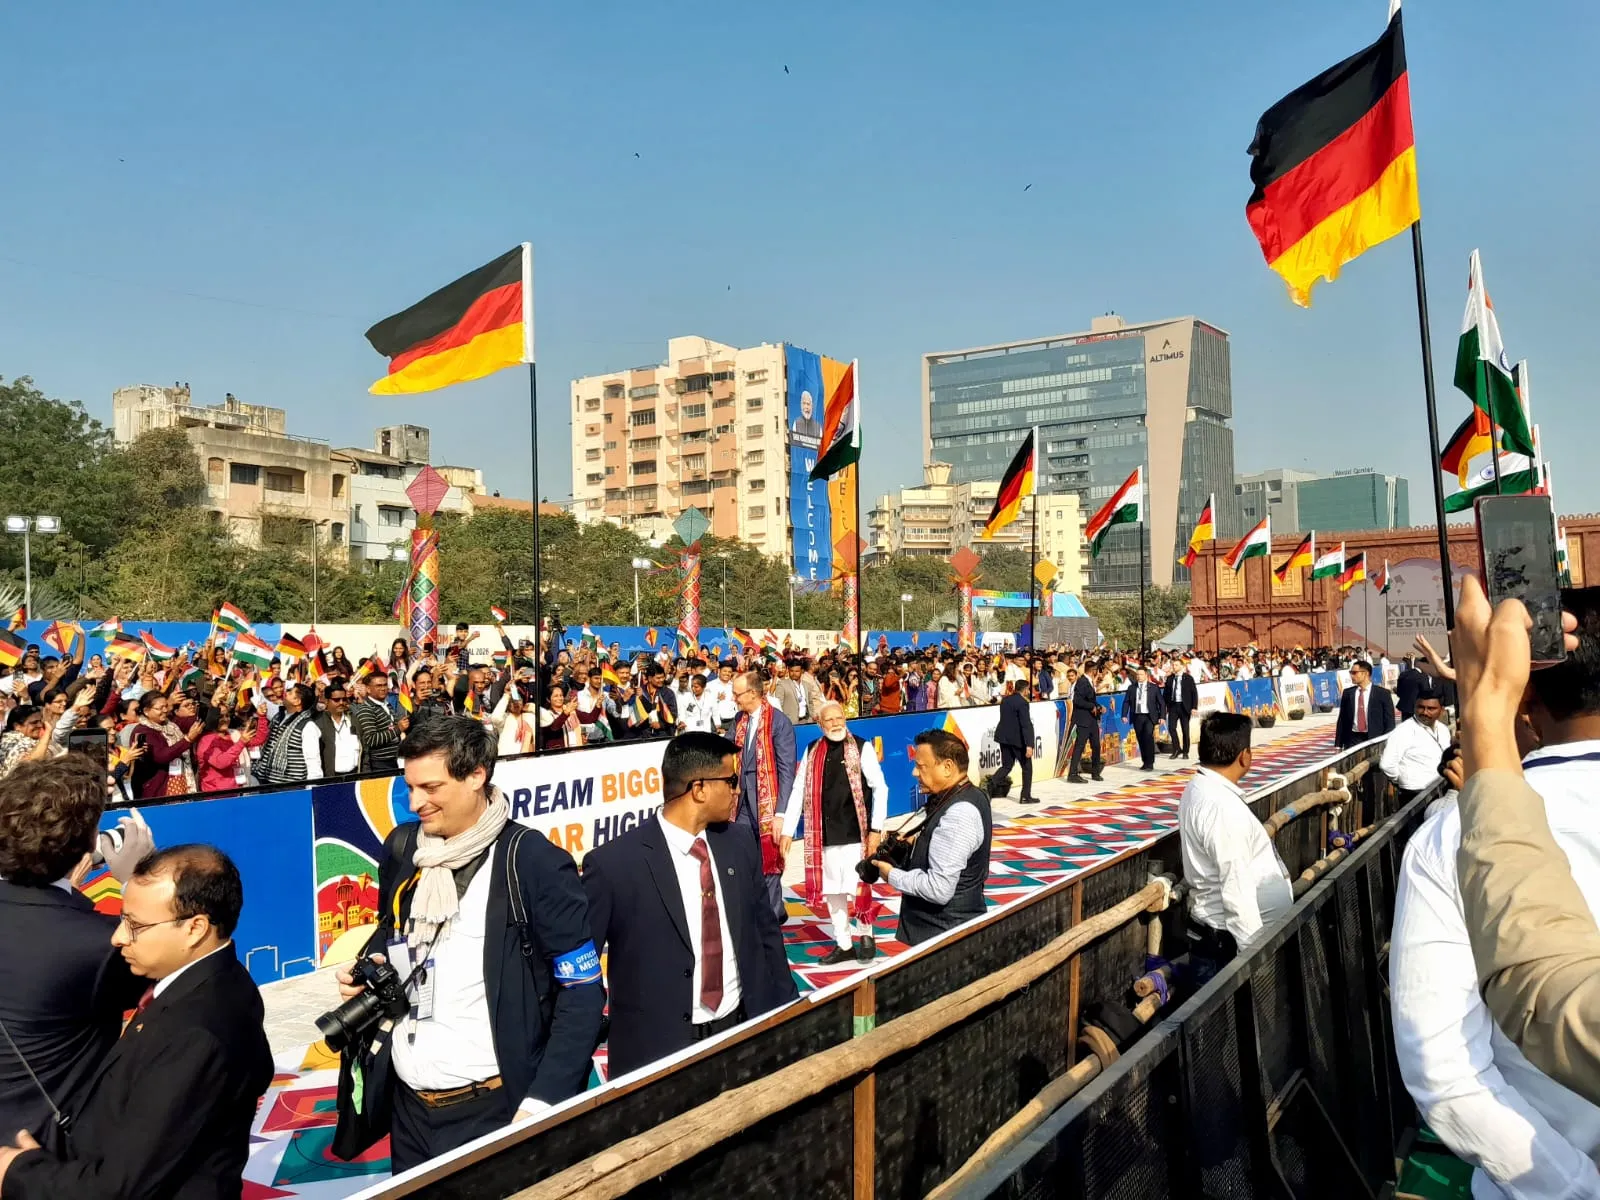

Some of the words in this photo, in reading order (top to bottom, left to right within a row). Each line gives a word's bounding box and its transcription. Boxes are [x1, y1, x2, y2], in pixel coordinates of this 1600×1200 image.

[1149, 350, 1185, 363] ALTIMUS
[1387, 603, 1431, 617] KITE
[1386, 617, 1445, 628] FESTIVA
[506, 777, 594, 820] REAM
[601, 766, 660, 803] BIGG
[549, 823, 584, 854] AR
[593, 806, 657, 848] HIG
